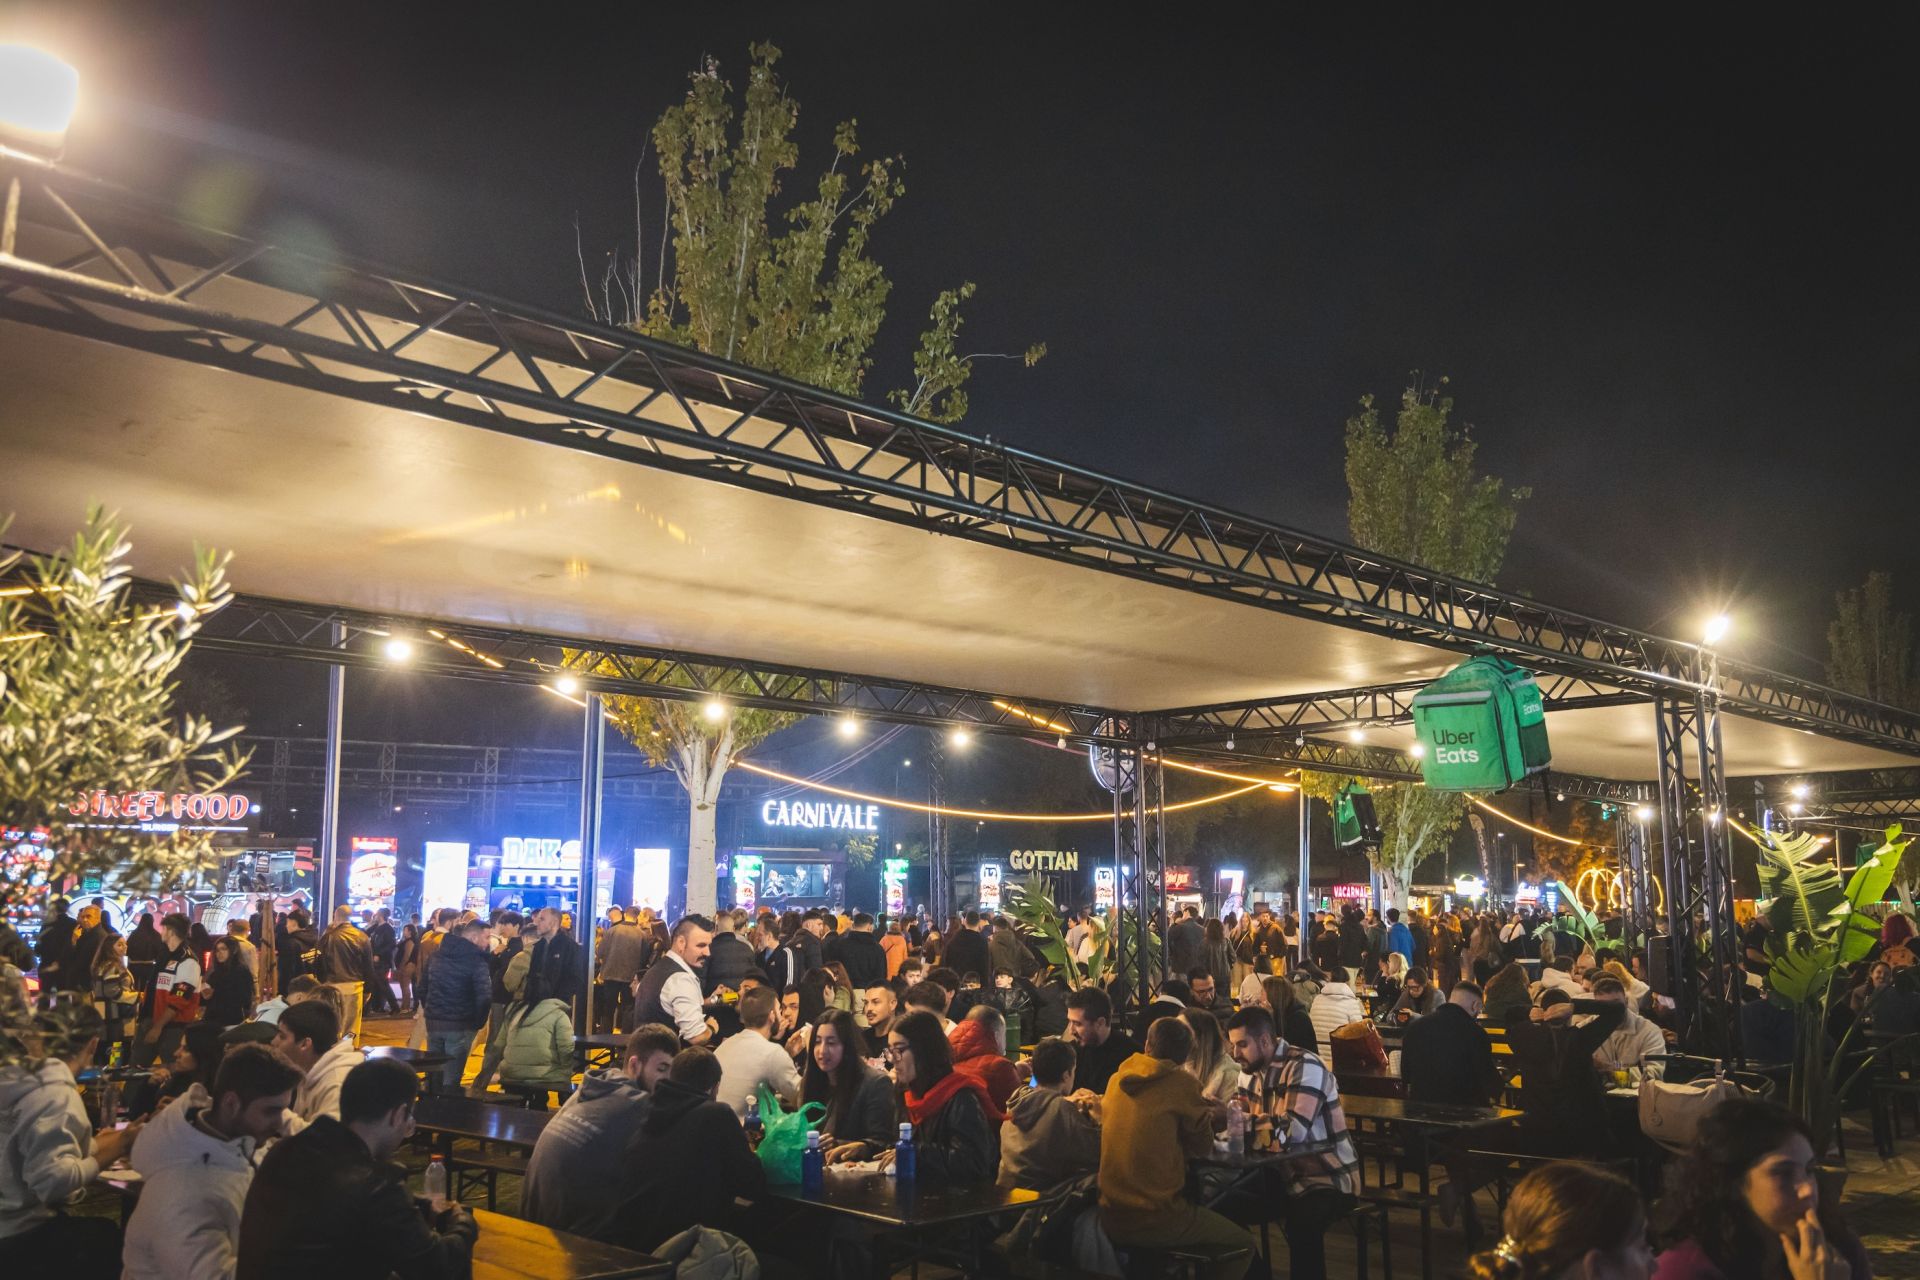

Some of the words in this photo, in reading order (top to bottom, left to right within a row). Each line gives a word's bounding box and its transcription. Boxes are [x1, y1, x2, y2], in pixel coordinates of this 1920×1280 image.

[1433, 729, 1475, 745] Uber
[1435, 748, 1480, 764] Eats
[171, 793, 249, 820] FOOD
[763, 800, 880, 829] CARNIVALE
[1009, 850, 1078, 871] GOTTAN
